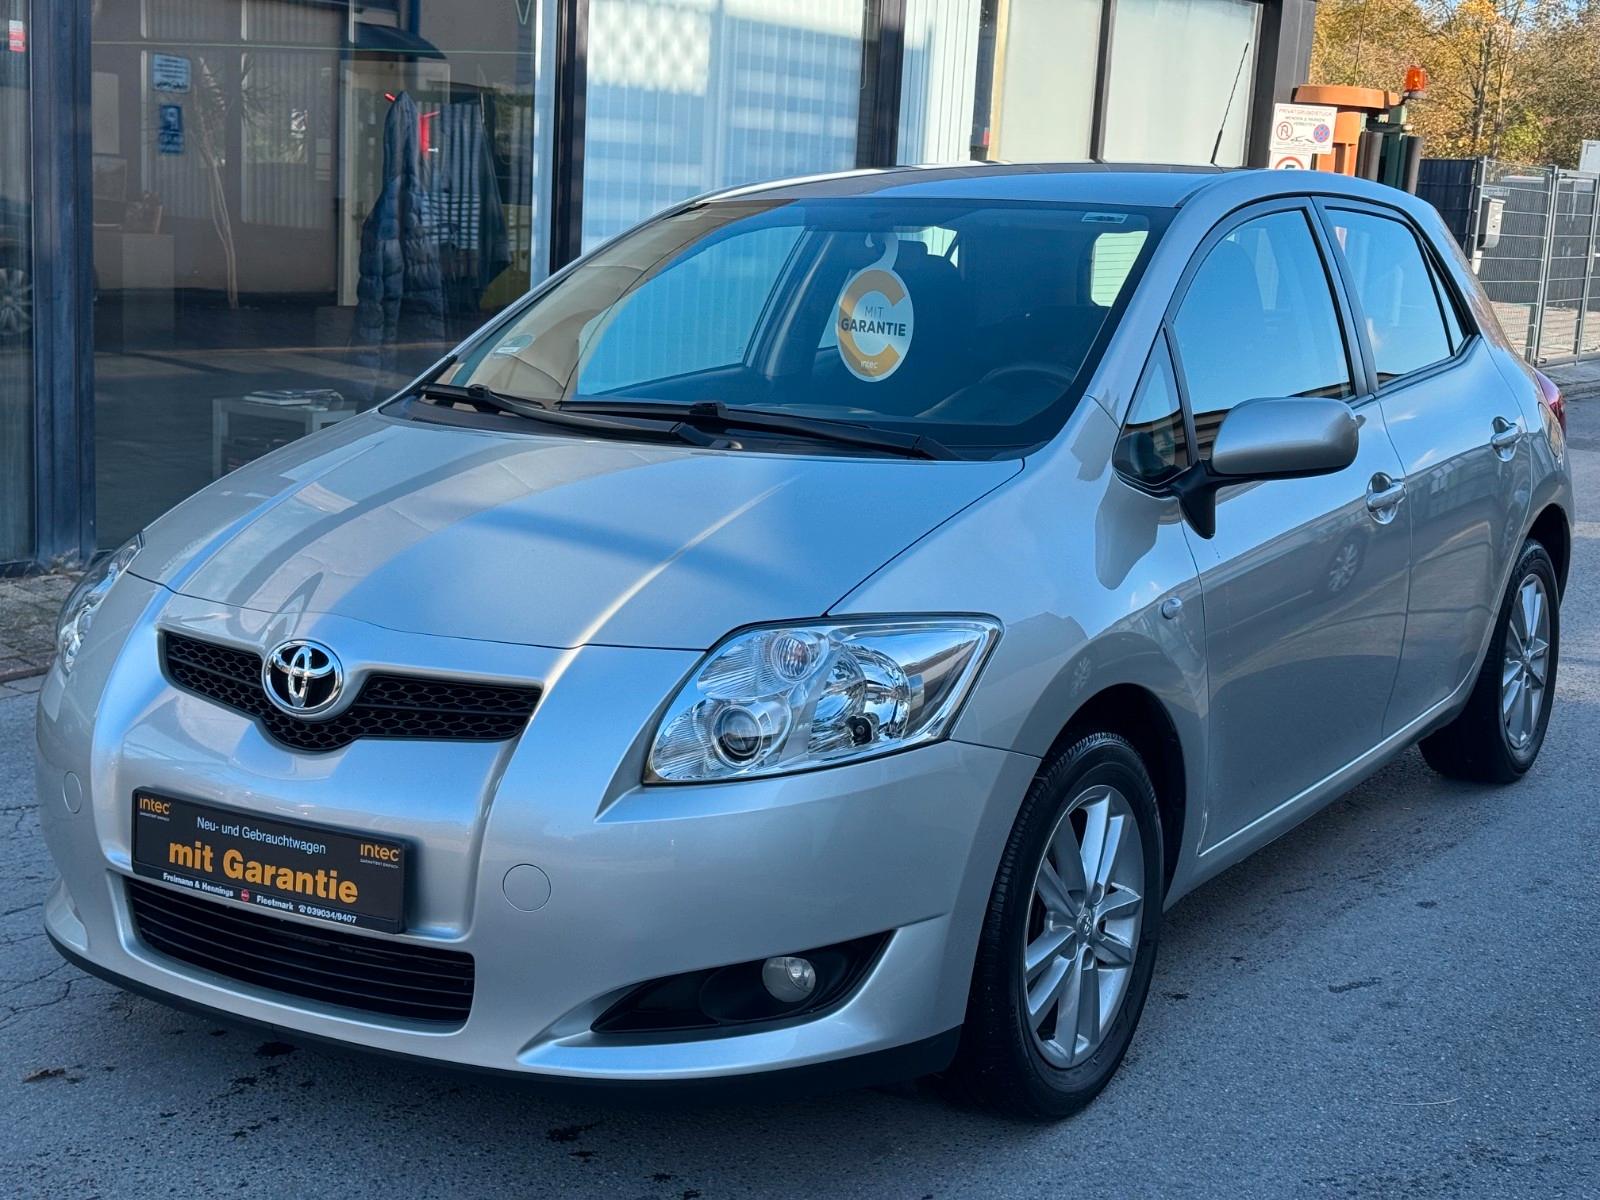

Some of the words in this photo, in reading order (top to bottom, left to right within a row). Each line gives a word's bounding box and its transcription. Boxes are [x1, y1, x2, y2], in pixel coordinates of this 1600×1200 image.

[864, 306, 885, 318] MIT
[841, 318, 907, 337] GARANTIE
[860, 359, 879, 369] intec
[139, 797, 171, 815] intec
[196, 816, 220, 832] Neu-
[221, 824, 240, 837] und
[241, 826, 327, 855] Gebrauchtwagen
[360, 843, 400, 862] intec
[168, 840, 214, 873] mit
[222, 848, 359, 904] Garantie
[194, 880, 201, 889] &
[201, 881, 234, 898] Hennings
